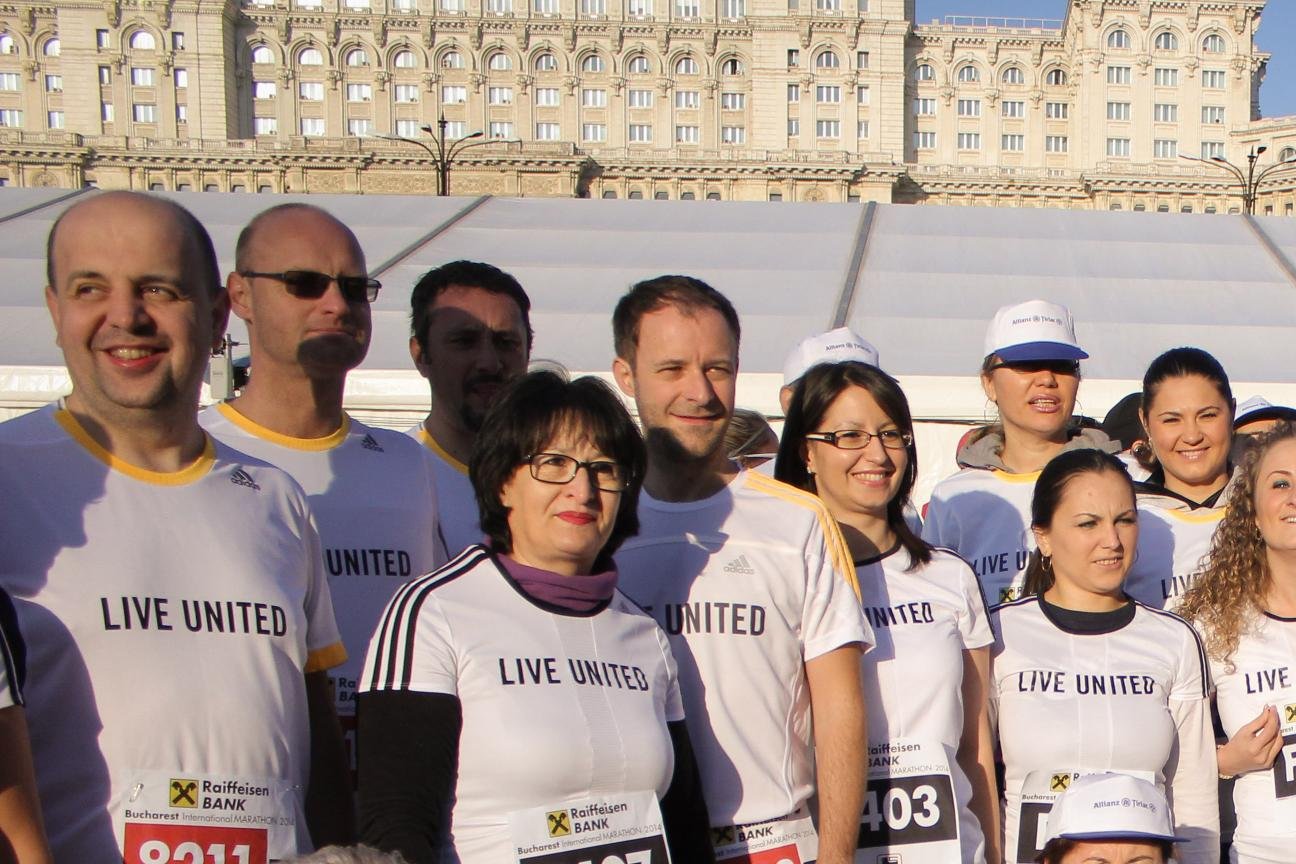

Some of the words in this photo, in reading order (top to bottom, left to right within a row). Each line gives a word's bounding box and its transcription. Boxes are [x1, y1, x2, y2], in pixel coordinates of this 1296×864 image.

[326, 549, 411, 577] UNITED
[101, 597, 172, 631] LIVE
[182, 600, 288, 637] UNITED
[665, 602, 766, 636] UNITED
[499, 658, 560, 685] LIVE
[568, 658, 649, 692] UNITED
[1018, 671, 1066, 693] LIVE
[1076, 674, 1155, 695] UNITED
[1245, 667, 1291, 694] LIVE
[202, 780, 270, 797] Raiffeisen
[1022, 793, 1056, 801] Bucharest
[203, 797, 247, 811] BANK
[571, 803, 628, 820] Raiffeisen
[125, 809, 179, 821] Bucharest
[182, 814, 233, 824] International
[574, 817, 610, 834] BANK
[737, 826, 774, 843] BANK
[517, 841, 561, 855] Bucharest
